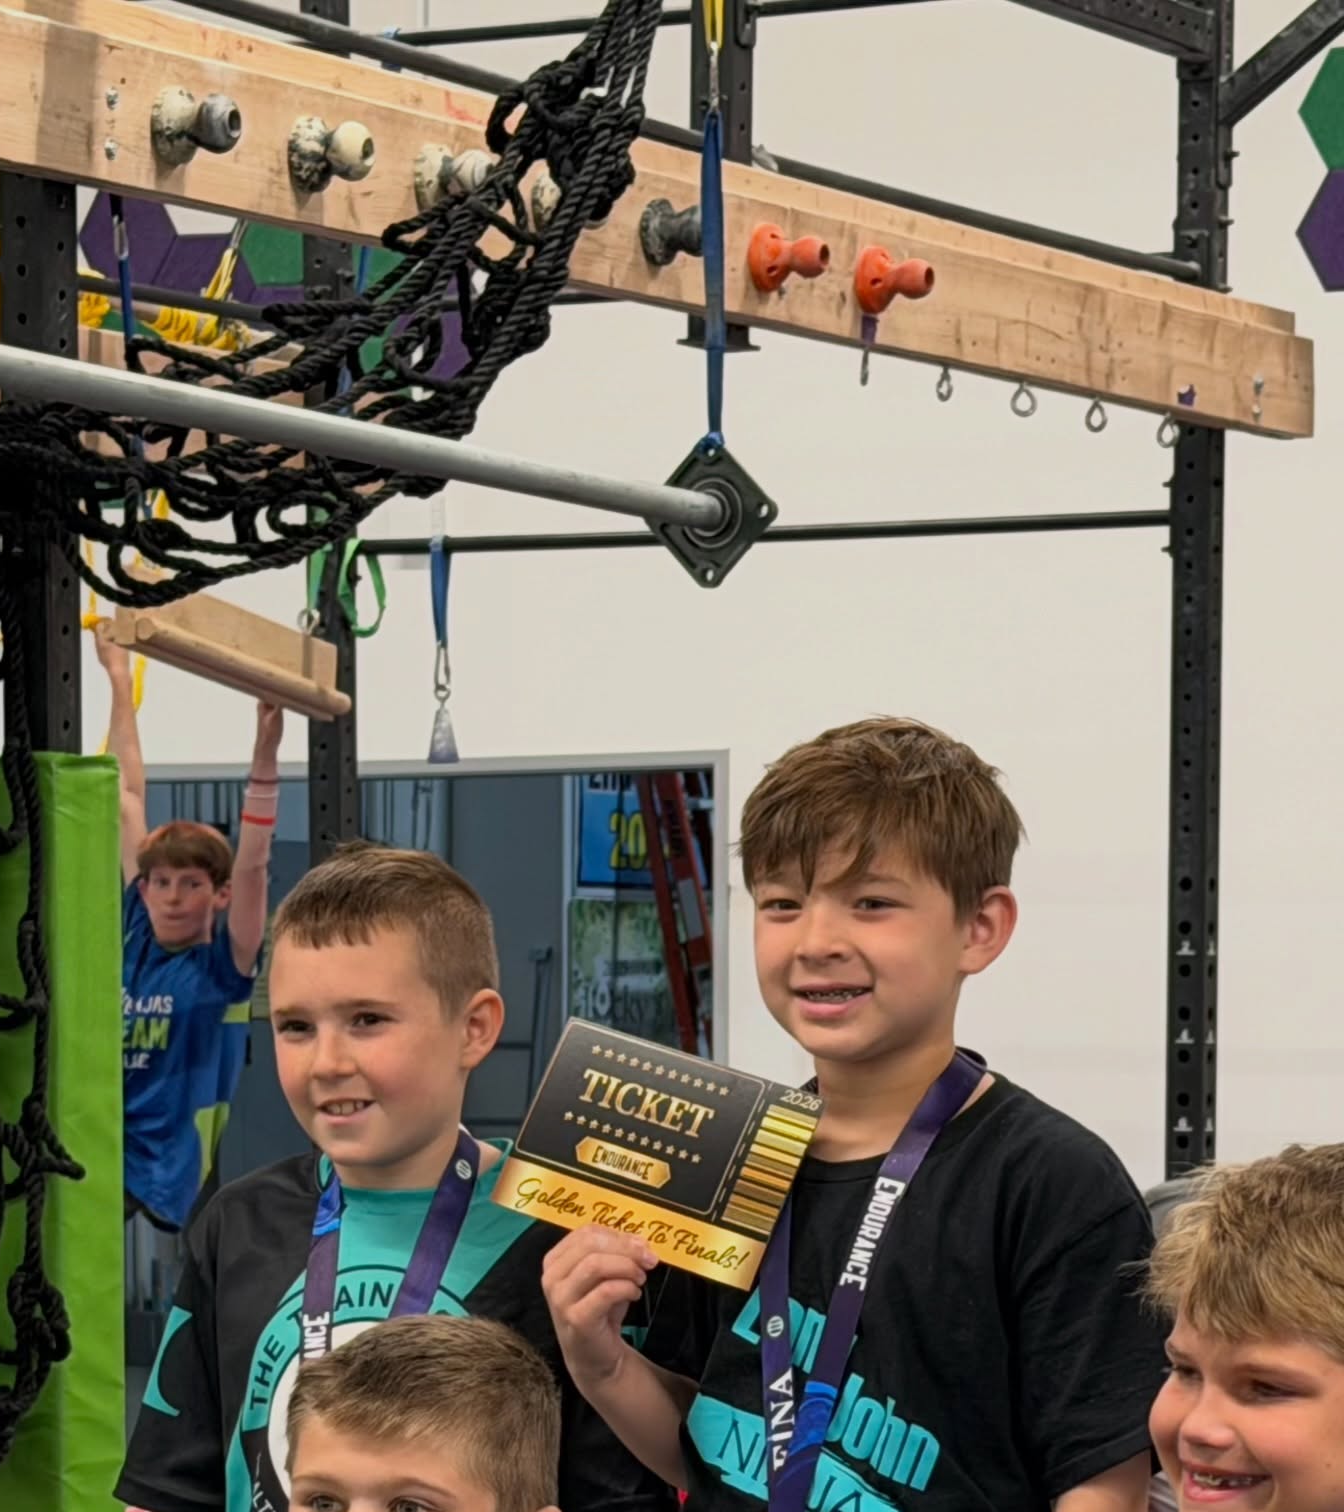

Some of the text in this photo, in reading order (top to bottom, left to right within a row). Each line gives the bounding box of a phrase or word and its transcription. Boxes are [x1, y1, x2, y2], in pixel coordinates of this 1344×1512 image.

[578, 1068, 715, 1138] TICKET
[779, 1089, 822, 1111] 2026
[591, 1145, 654, 1181] ENDURANCE
[516, 1177, 749, 1270] Golden Ticket To Finals!
[839, 1176, 906, 1291] ENDURANCE
[249, 1334, 285, 1412] THE
[768, 1367, 795, 1471] FINA
[825, 1373, 941, 1492] John
